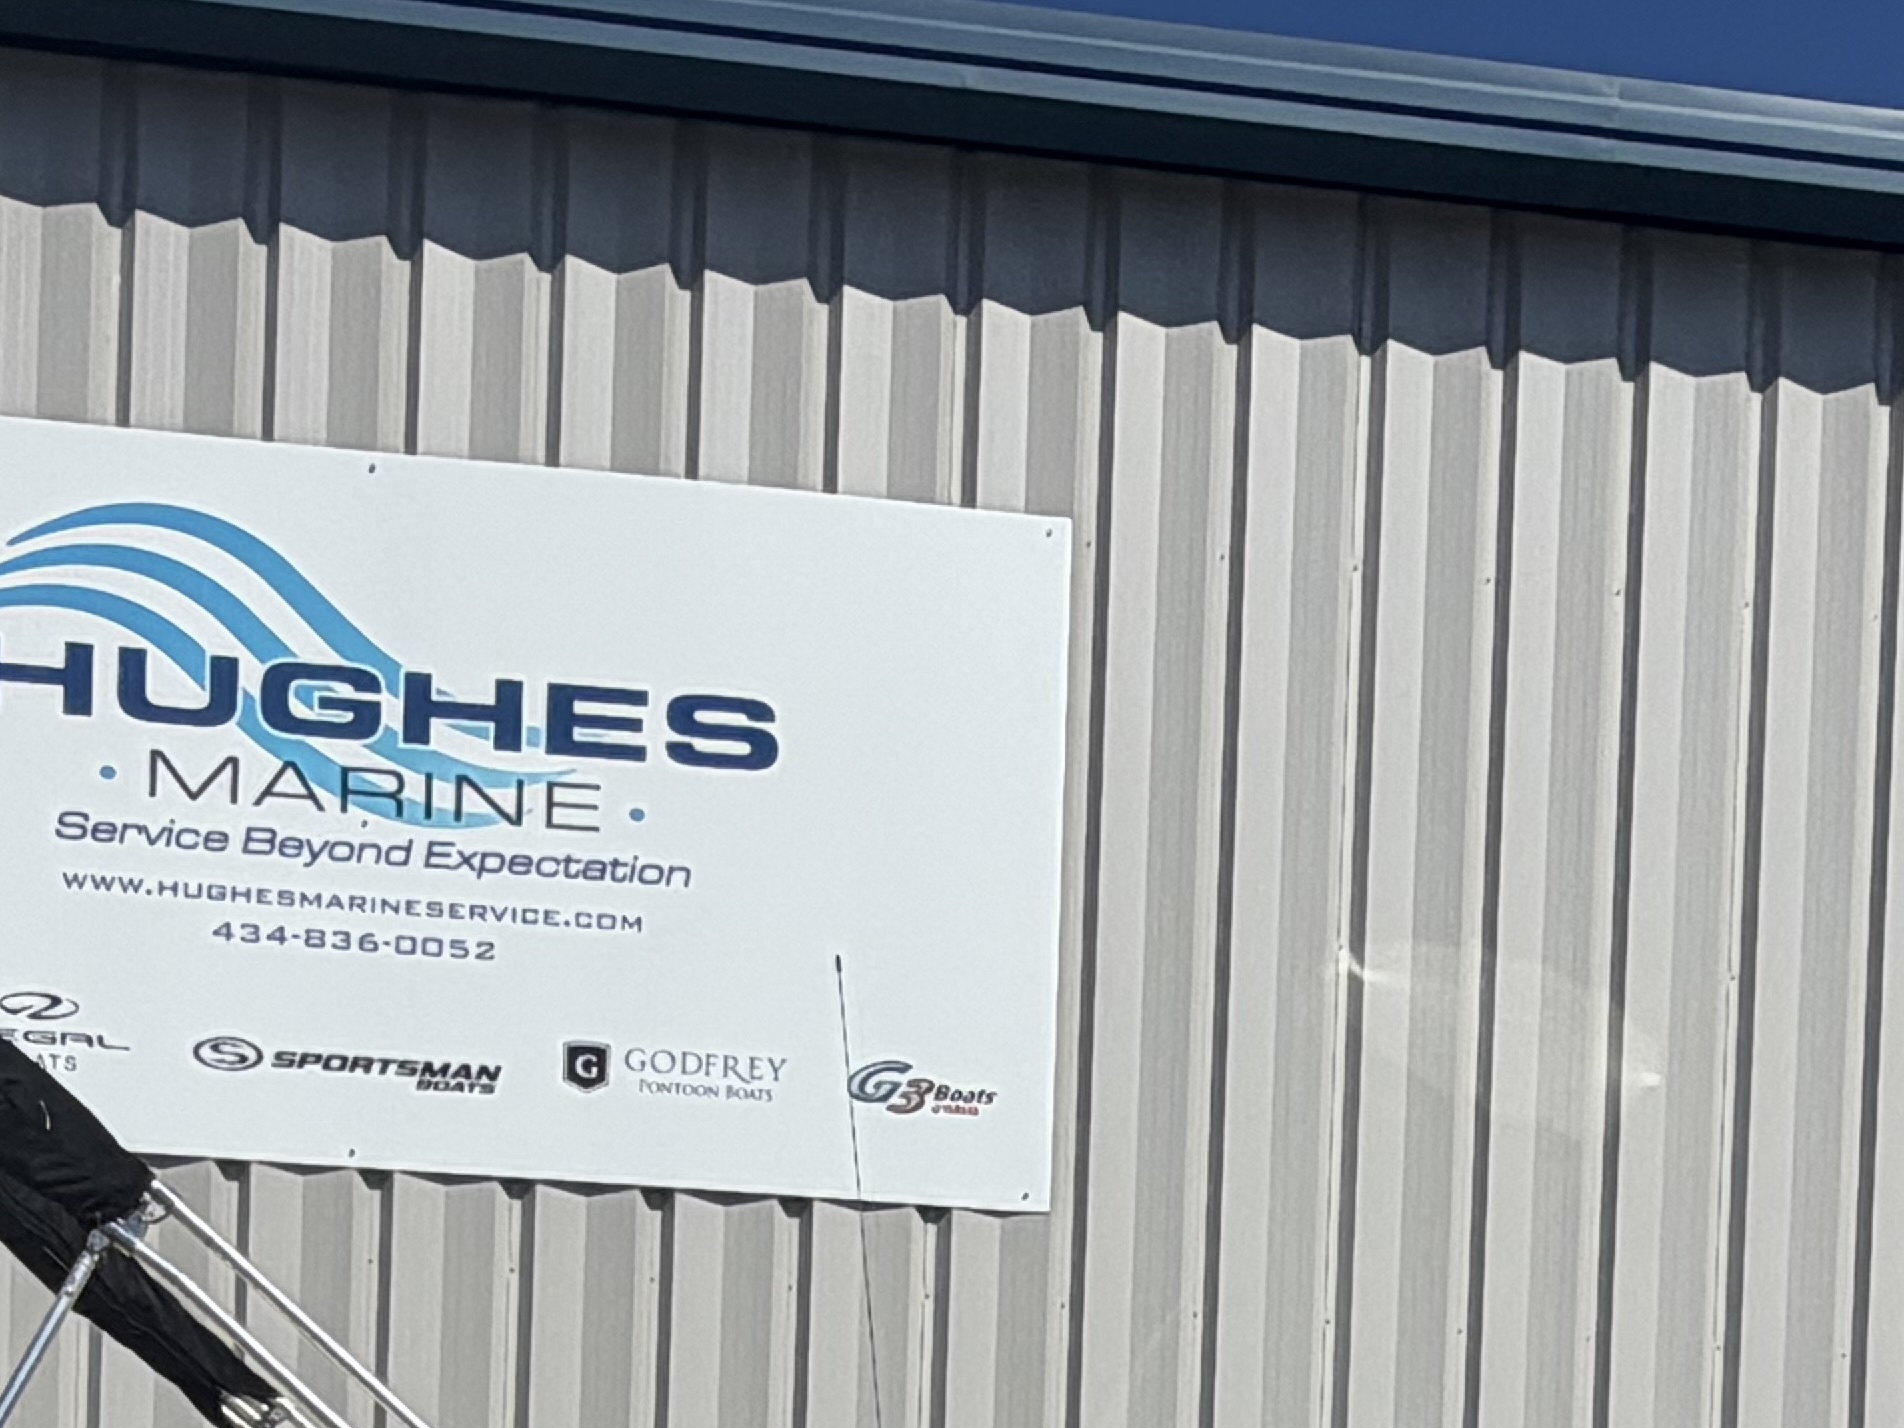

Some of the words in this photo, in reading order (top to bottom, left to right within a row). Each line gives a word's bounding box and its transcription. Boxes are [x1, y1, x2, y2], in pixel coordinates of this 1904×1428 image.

[147, 748, 603, 834] MARINE
[55, 812, 228, 854] Service
[241, 828, 413, 871] Beyond
[423, 842, 692, 890] Expectation
[62, 872, 644, 934] WWW.HUGHESMARINESERVICE.COM
[211, 922, 497, 961] 434-836-0052
[270, 1050, 502, 1082] SPORTSMAN
[624, 1047, 788, 1083] GODFREY
[416, 1080, 496, 1094] BOATS
[638, 1078, 721, 1097] PONTOON
[726, 1083, 773, 1102] BOATS
